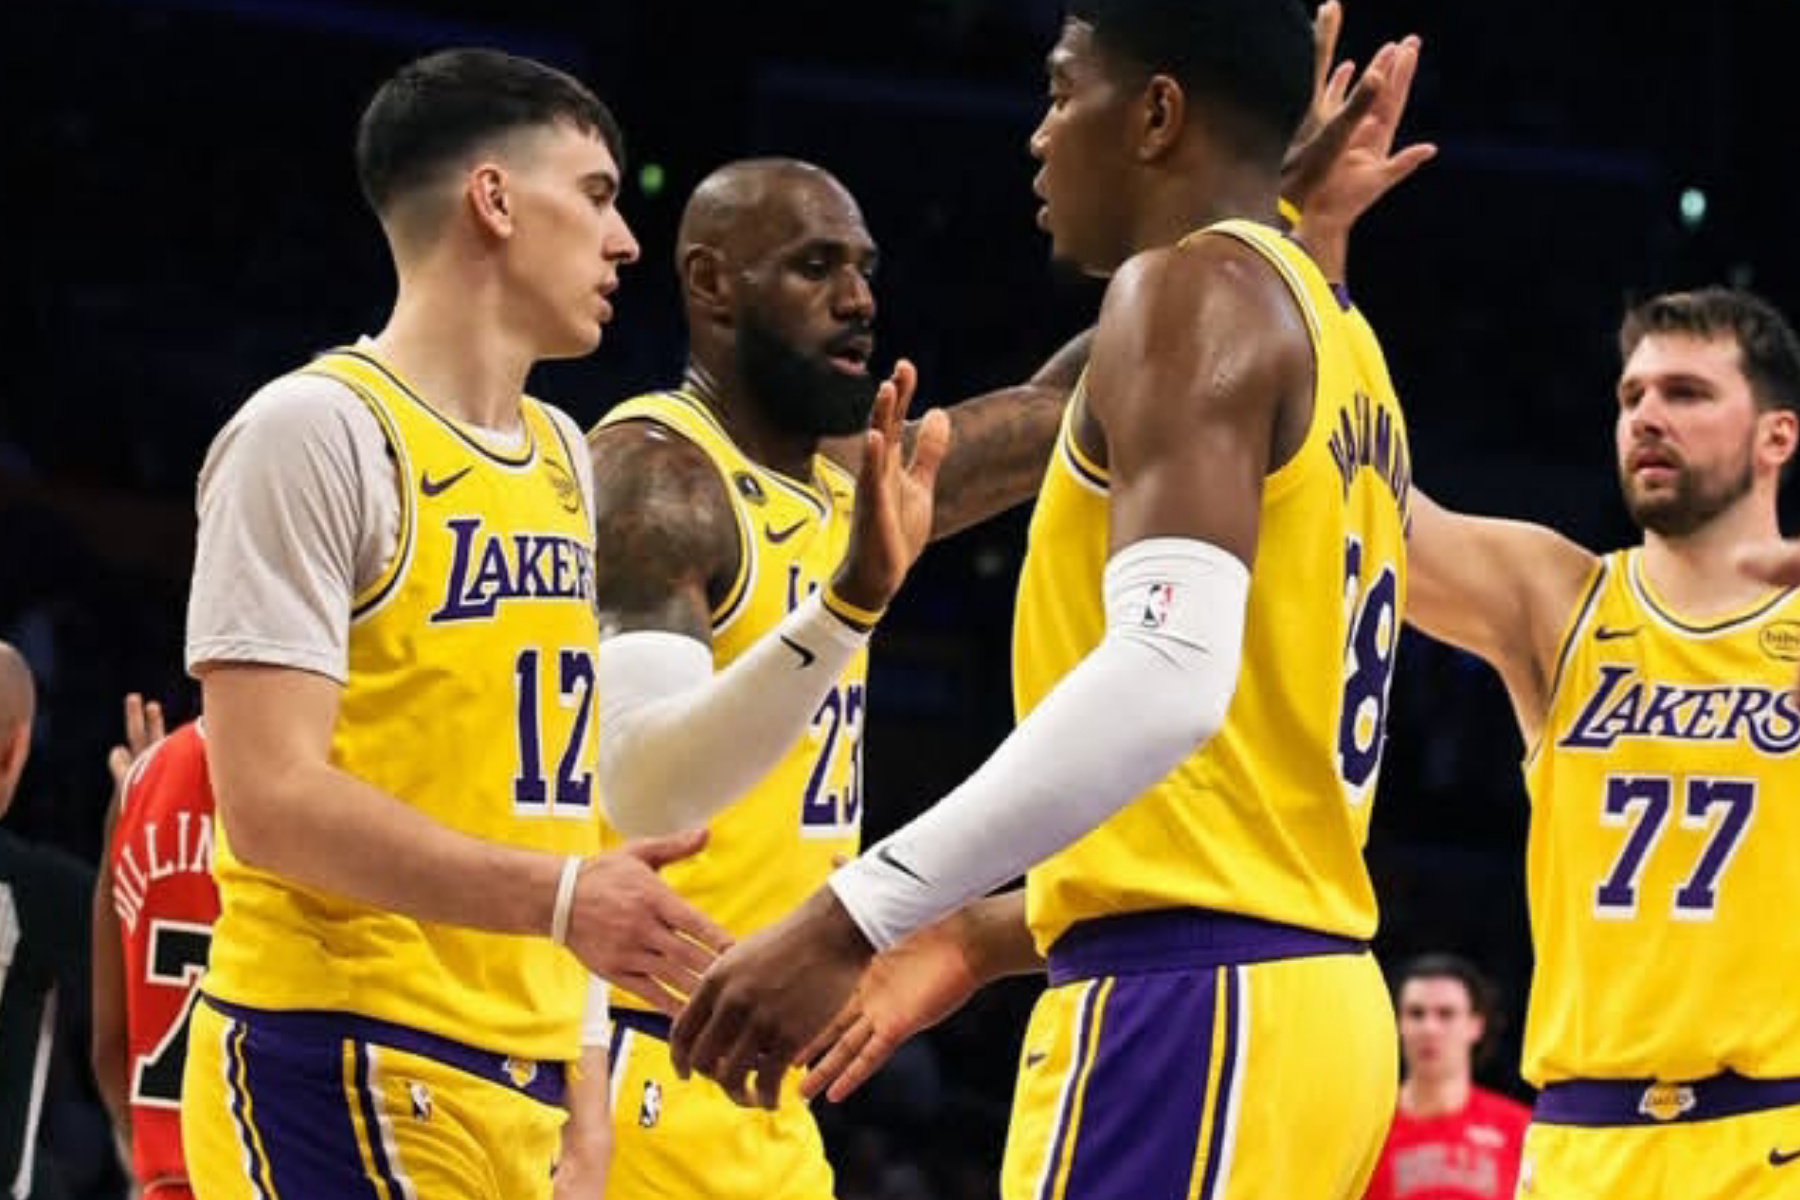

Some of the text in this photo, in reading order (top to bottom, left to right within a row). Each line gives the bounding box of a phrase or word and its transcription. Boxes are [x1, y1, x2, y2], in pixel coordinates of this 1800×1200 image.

[513, 649, 597, 807] 12
[801, 685, 863, 826] 23
[1556, 665, 1799, 754] LAKERS
[1595, 775, 1758, 911] 77
[130, 919, 212, 1108] 7
